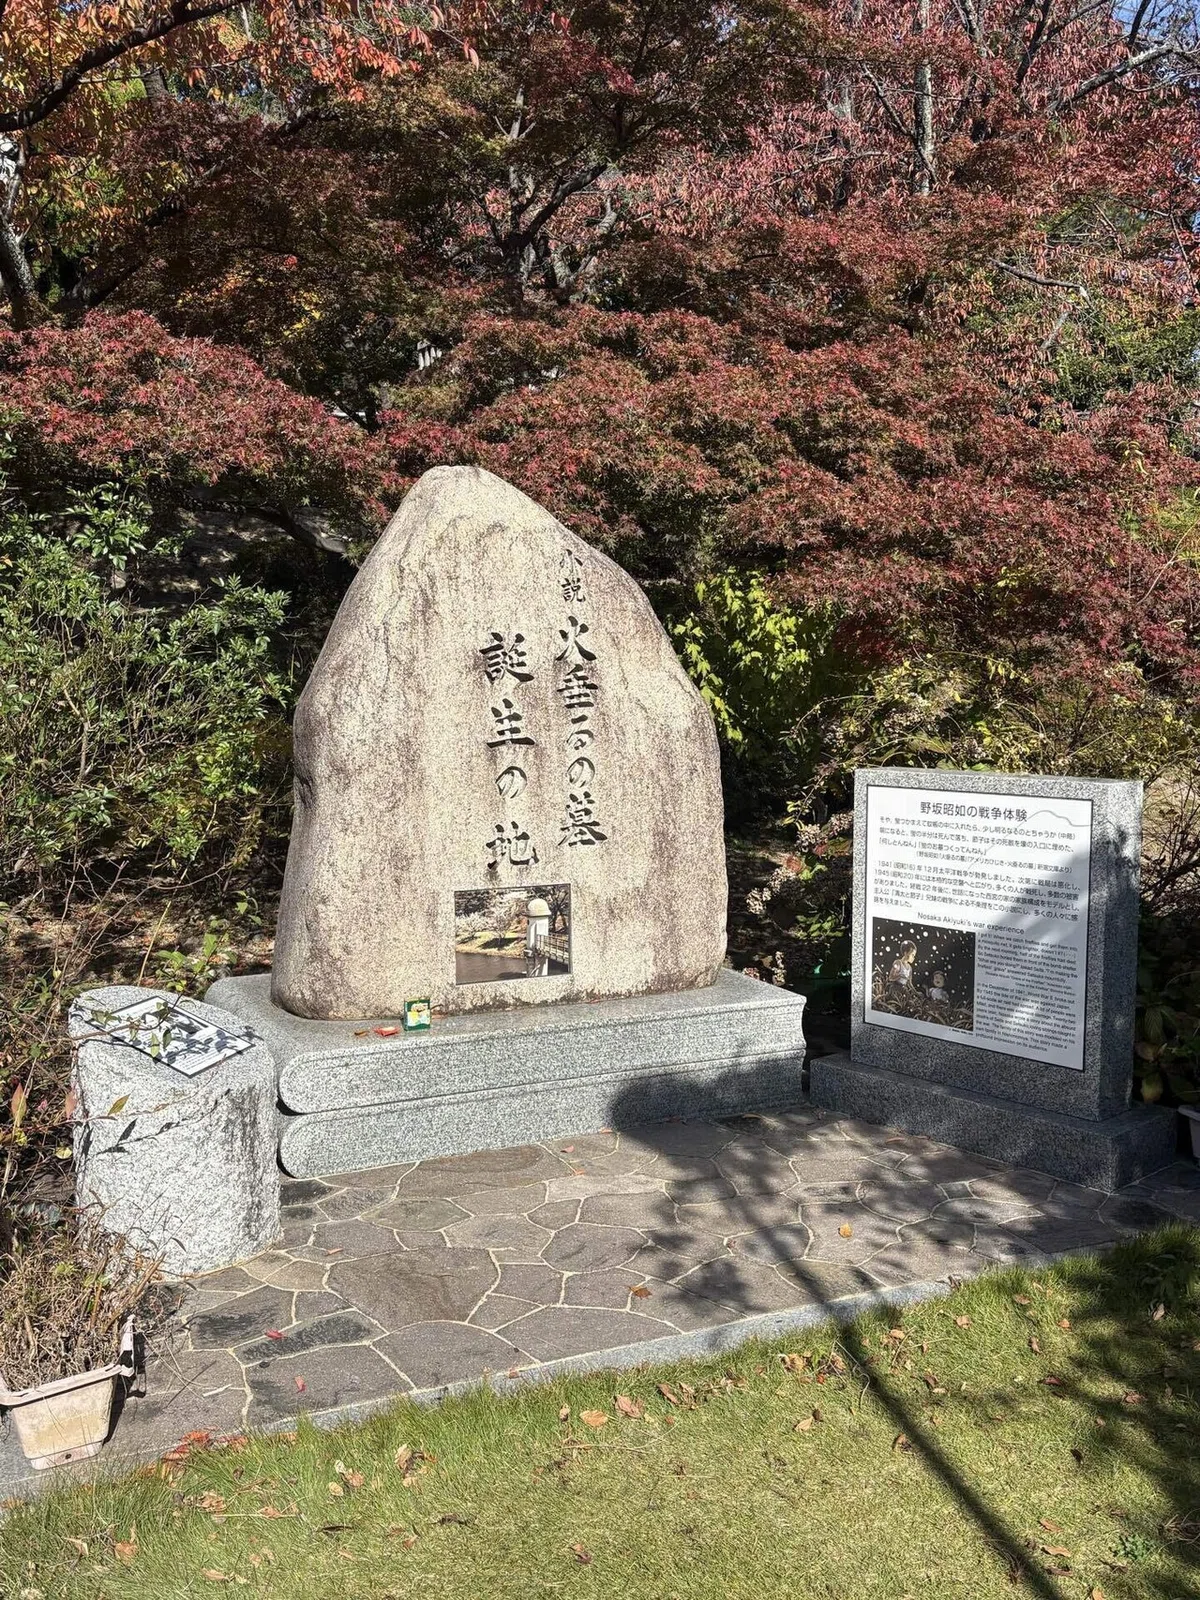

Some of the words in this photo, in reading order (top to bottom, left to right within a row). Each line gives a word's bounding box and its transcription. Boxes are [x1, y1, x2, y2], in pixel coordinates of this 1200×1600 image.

[478, 631, 540, 871] 誕生の地
[555, 615, 609, 847] 火垂るの墓
[920, 801, 1027, 822] 野坂昭如の戦争体験
[917, 911, 941, 922] Nosaka
[942, 915, 971, 927] Akiyuki's
[986, 923, 1024, 935] experience
